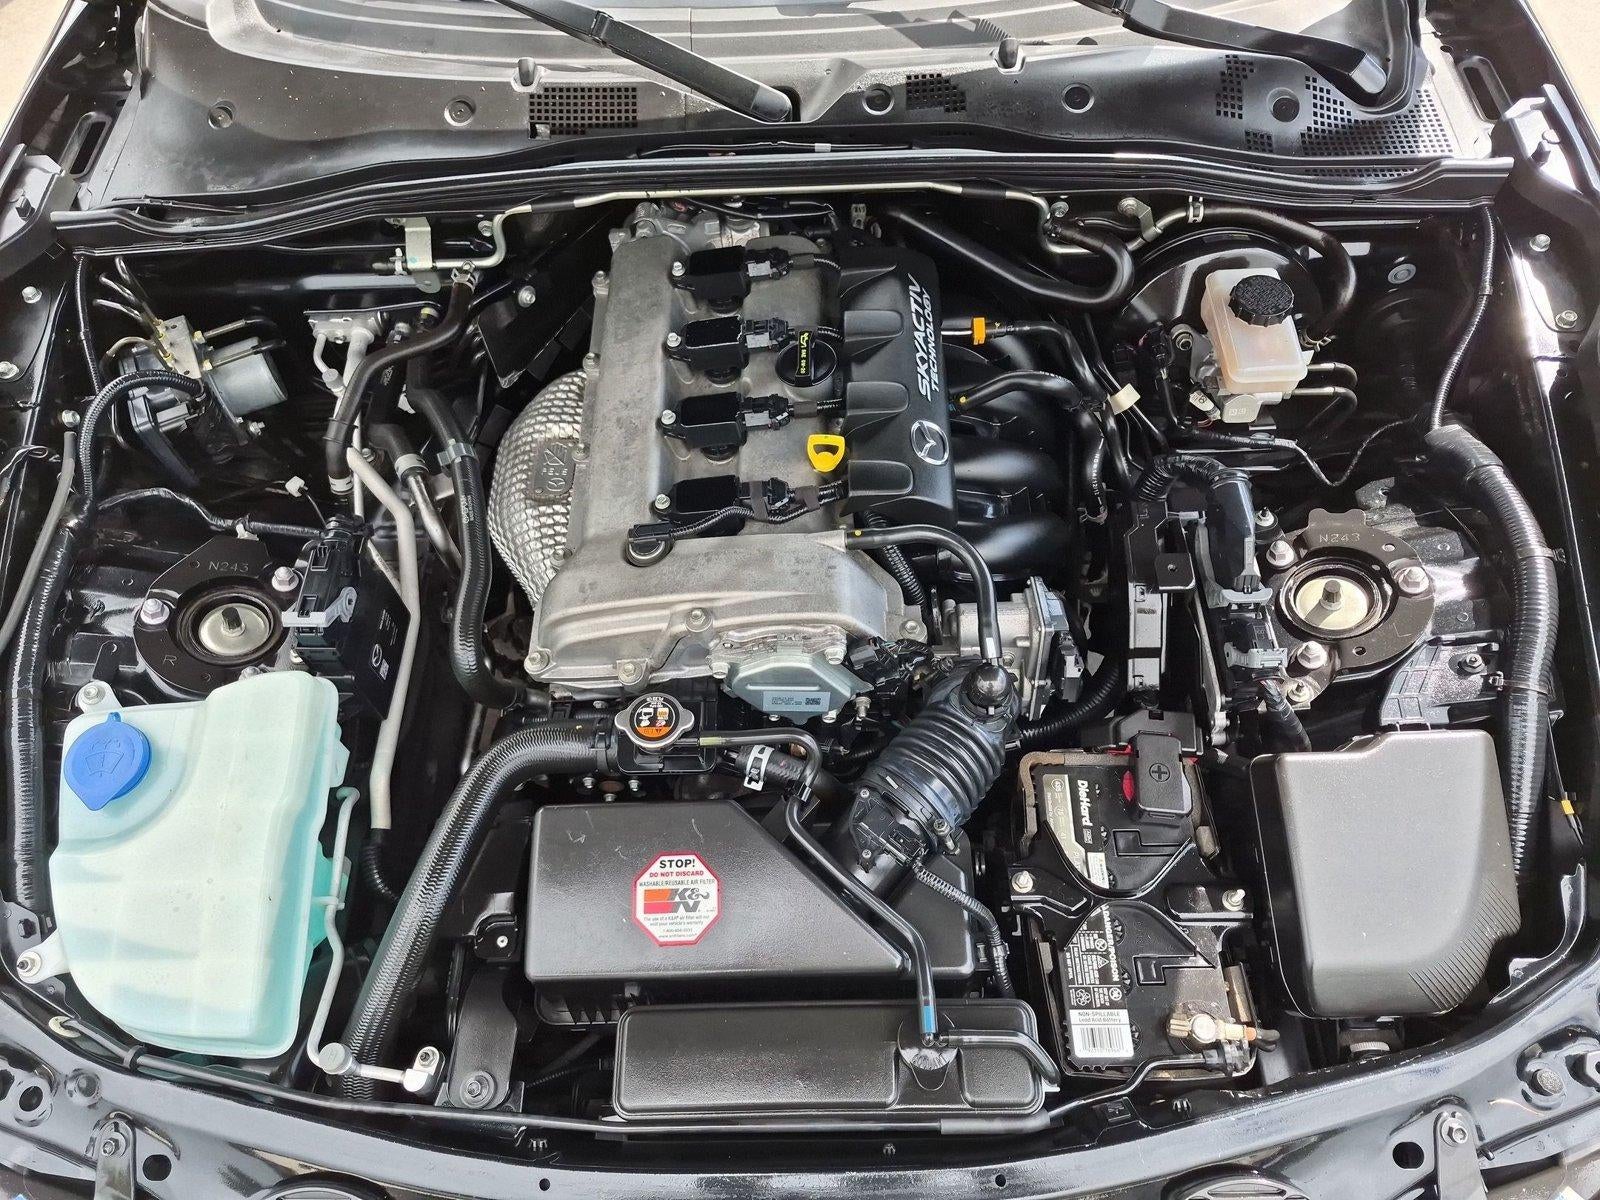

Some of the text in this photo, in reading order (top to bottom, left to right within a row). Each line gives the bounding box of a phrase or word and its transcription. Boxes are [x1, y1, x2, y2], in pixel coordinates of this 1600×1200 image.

[908, 272, 932, 402] SKYACTIV
[922, 286, 940, 392] TECHNOLOGY
[1319, 532, 1361, 543] N243
[208, 560, 249, 573] N243
[1077, 779, 1093, 827] DieHard
[660, 859, 696, 869] STOP!
[1103, 910, 1119, 982] DANGER/POISON
